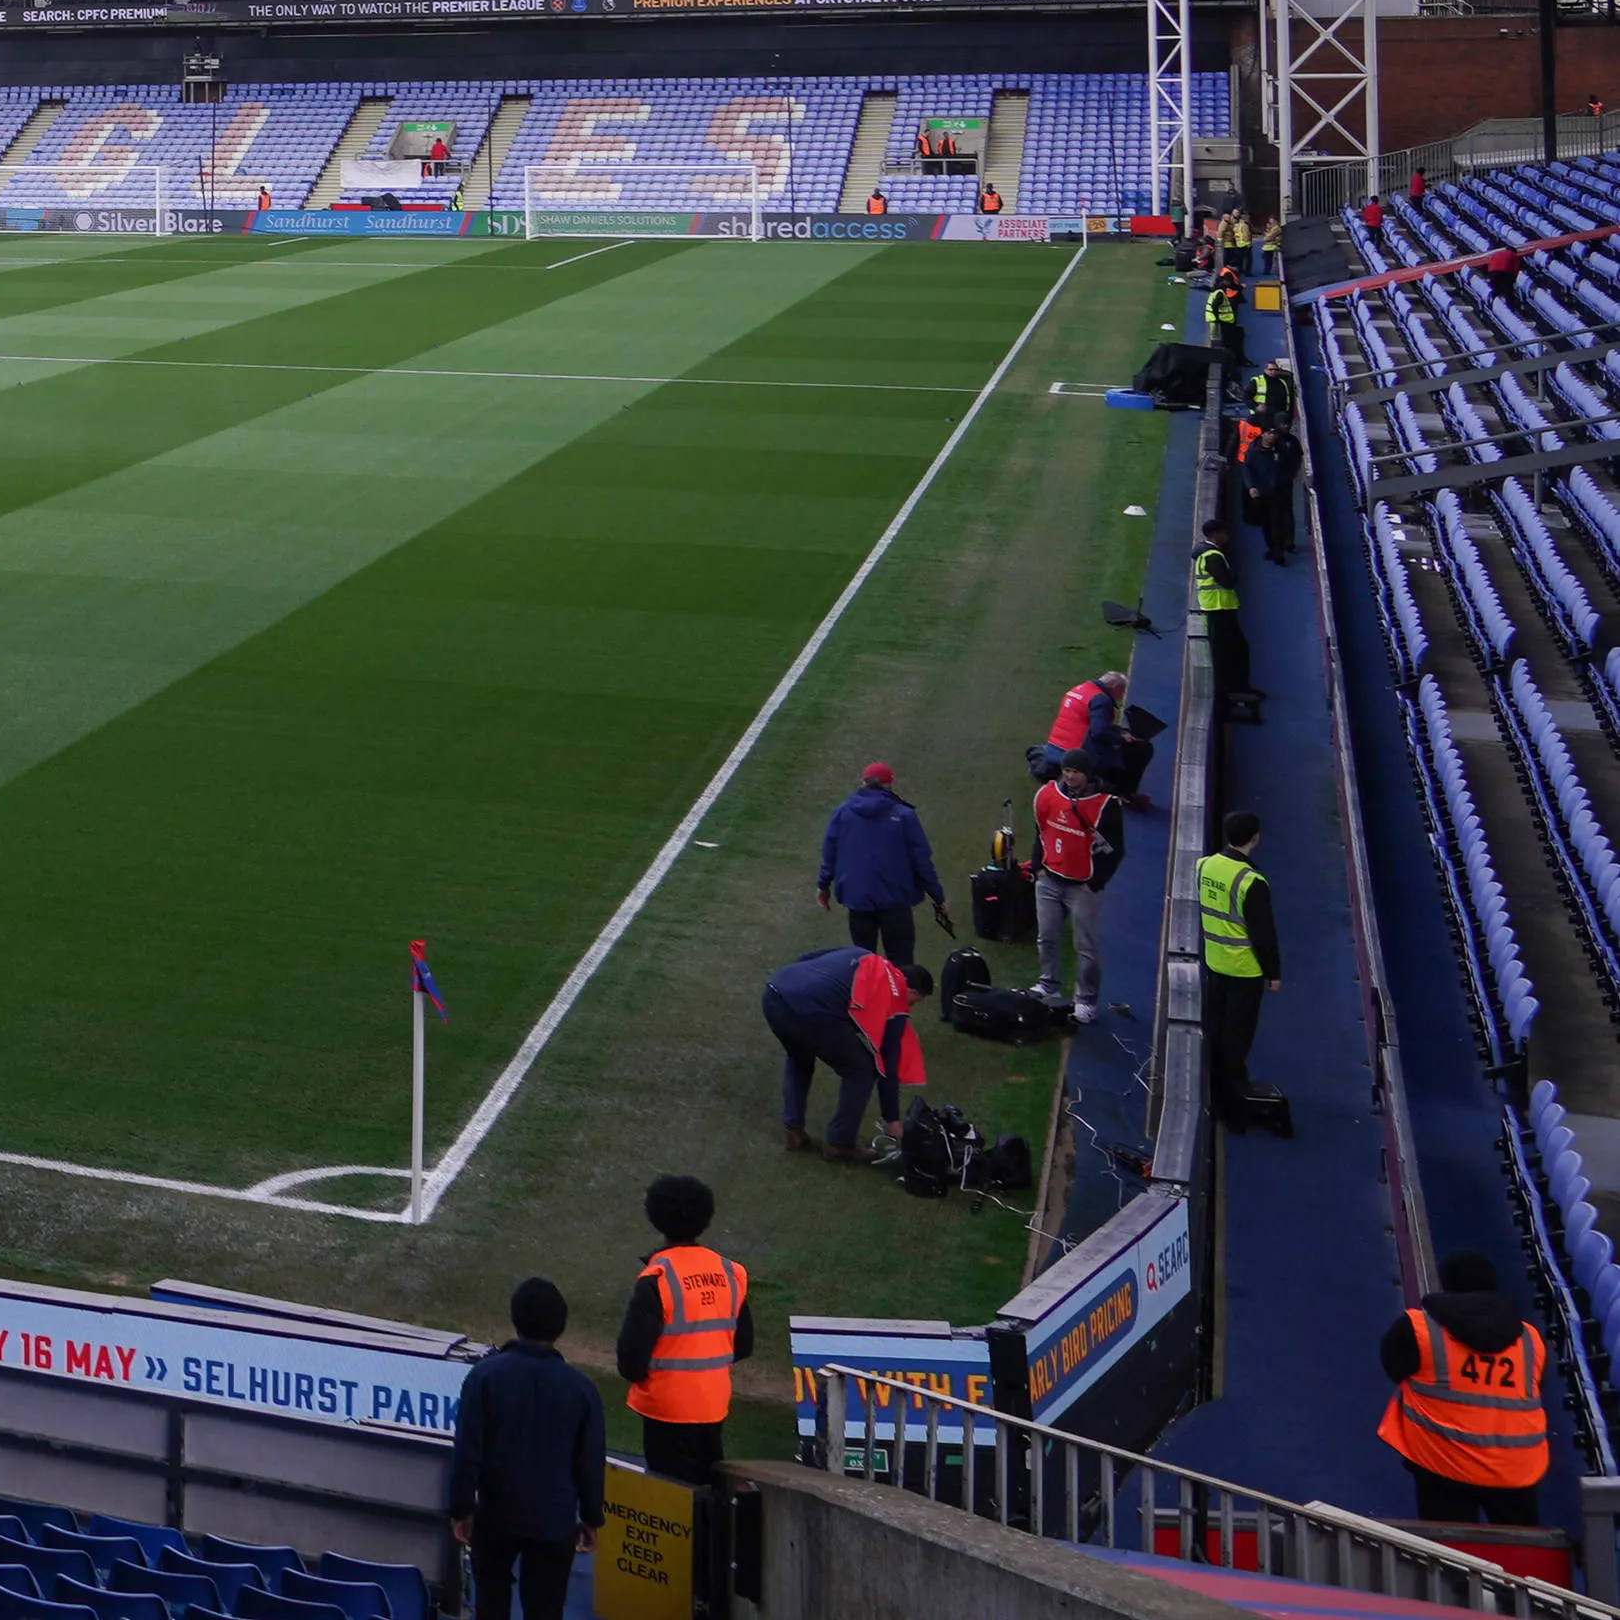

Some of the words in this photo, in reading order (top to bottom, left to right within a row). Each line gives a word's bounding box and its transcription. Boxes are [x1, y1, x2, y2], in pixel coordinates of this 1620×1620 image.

[99, 211, 158, 232] Silver
[165, 211, 222, 233] Blaze
[265, 213, 350, 229] Sandhurst
[366, 213, 451, 230] Sandhurst
[541, 216, 570, 224] SHAW
[573, 216, 615, 225] DANIELS
[618, 216, 676, 226] SOLUTIONS
[998, 219, 1048, 229] ASSOCIATE
[998, 229, 1046, 239] PARTNERS
[683, 1273, 727, 1291] STEWARD
[1062, 1327, 1088, 1376] BIRD
[1090, 1281, 1132, 1349] PRICING
[1461, 1353, 1516, 1388] 472
[20, 1332, 52, 1370] 16
[65, 1340, 137, 1383] MAY
[182, 1356, 359, 1419] SELHURST
[371, 1385, 460, 1432] PARK
[604, 1501, 692, 1540] MERGENCY
[625, 1524, 659, 1547] EXIT
[622, 1540, 664, 1564] KEEP
[617, 1556, 669, 1587] CLEAR
